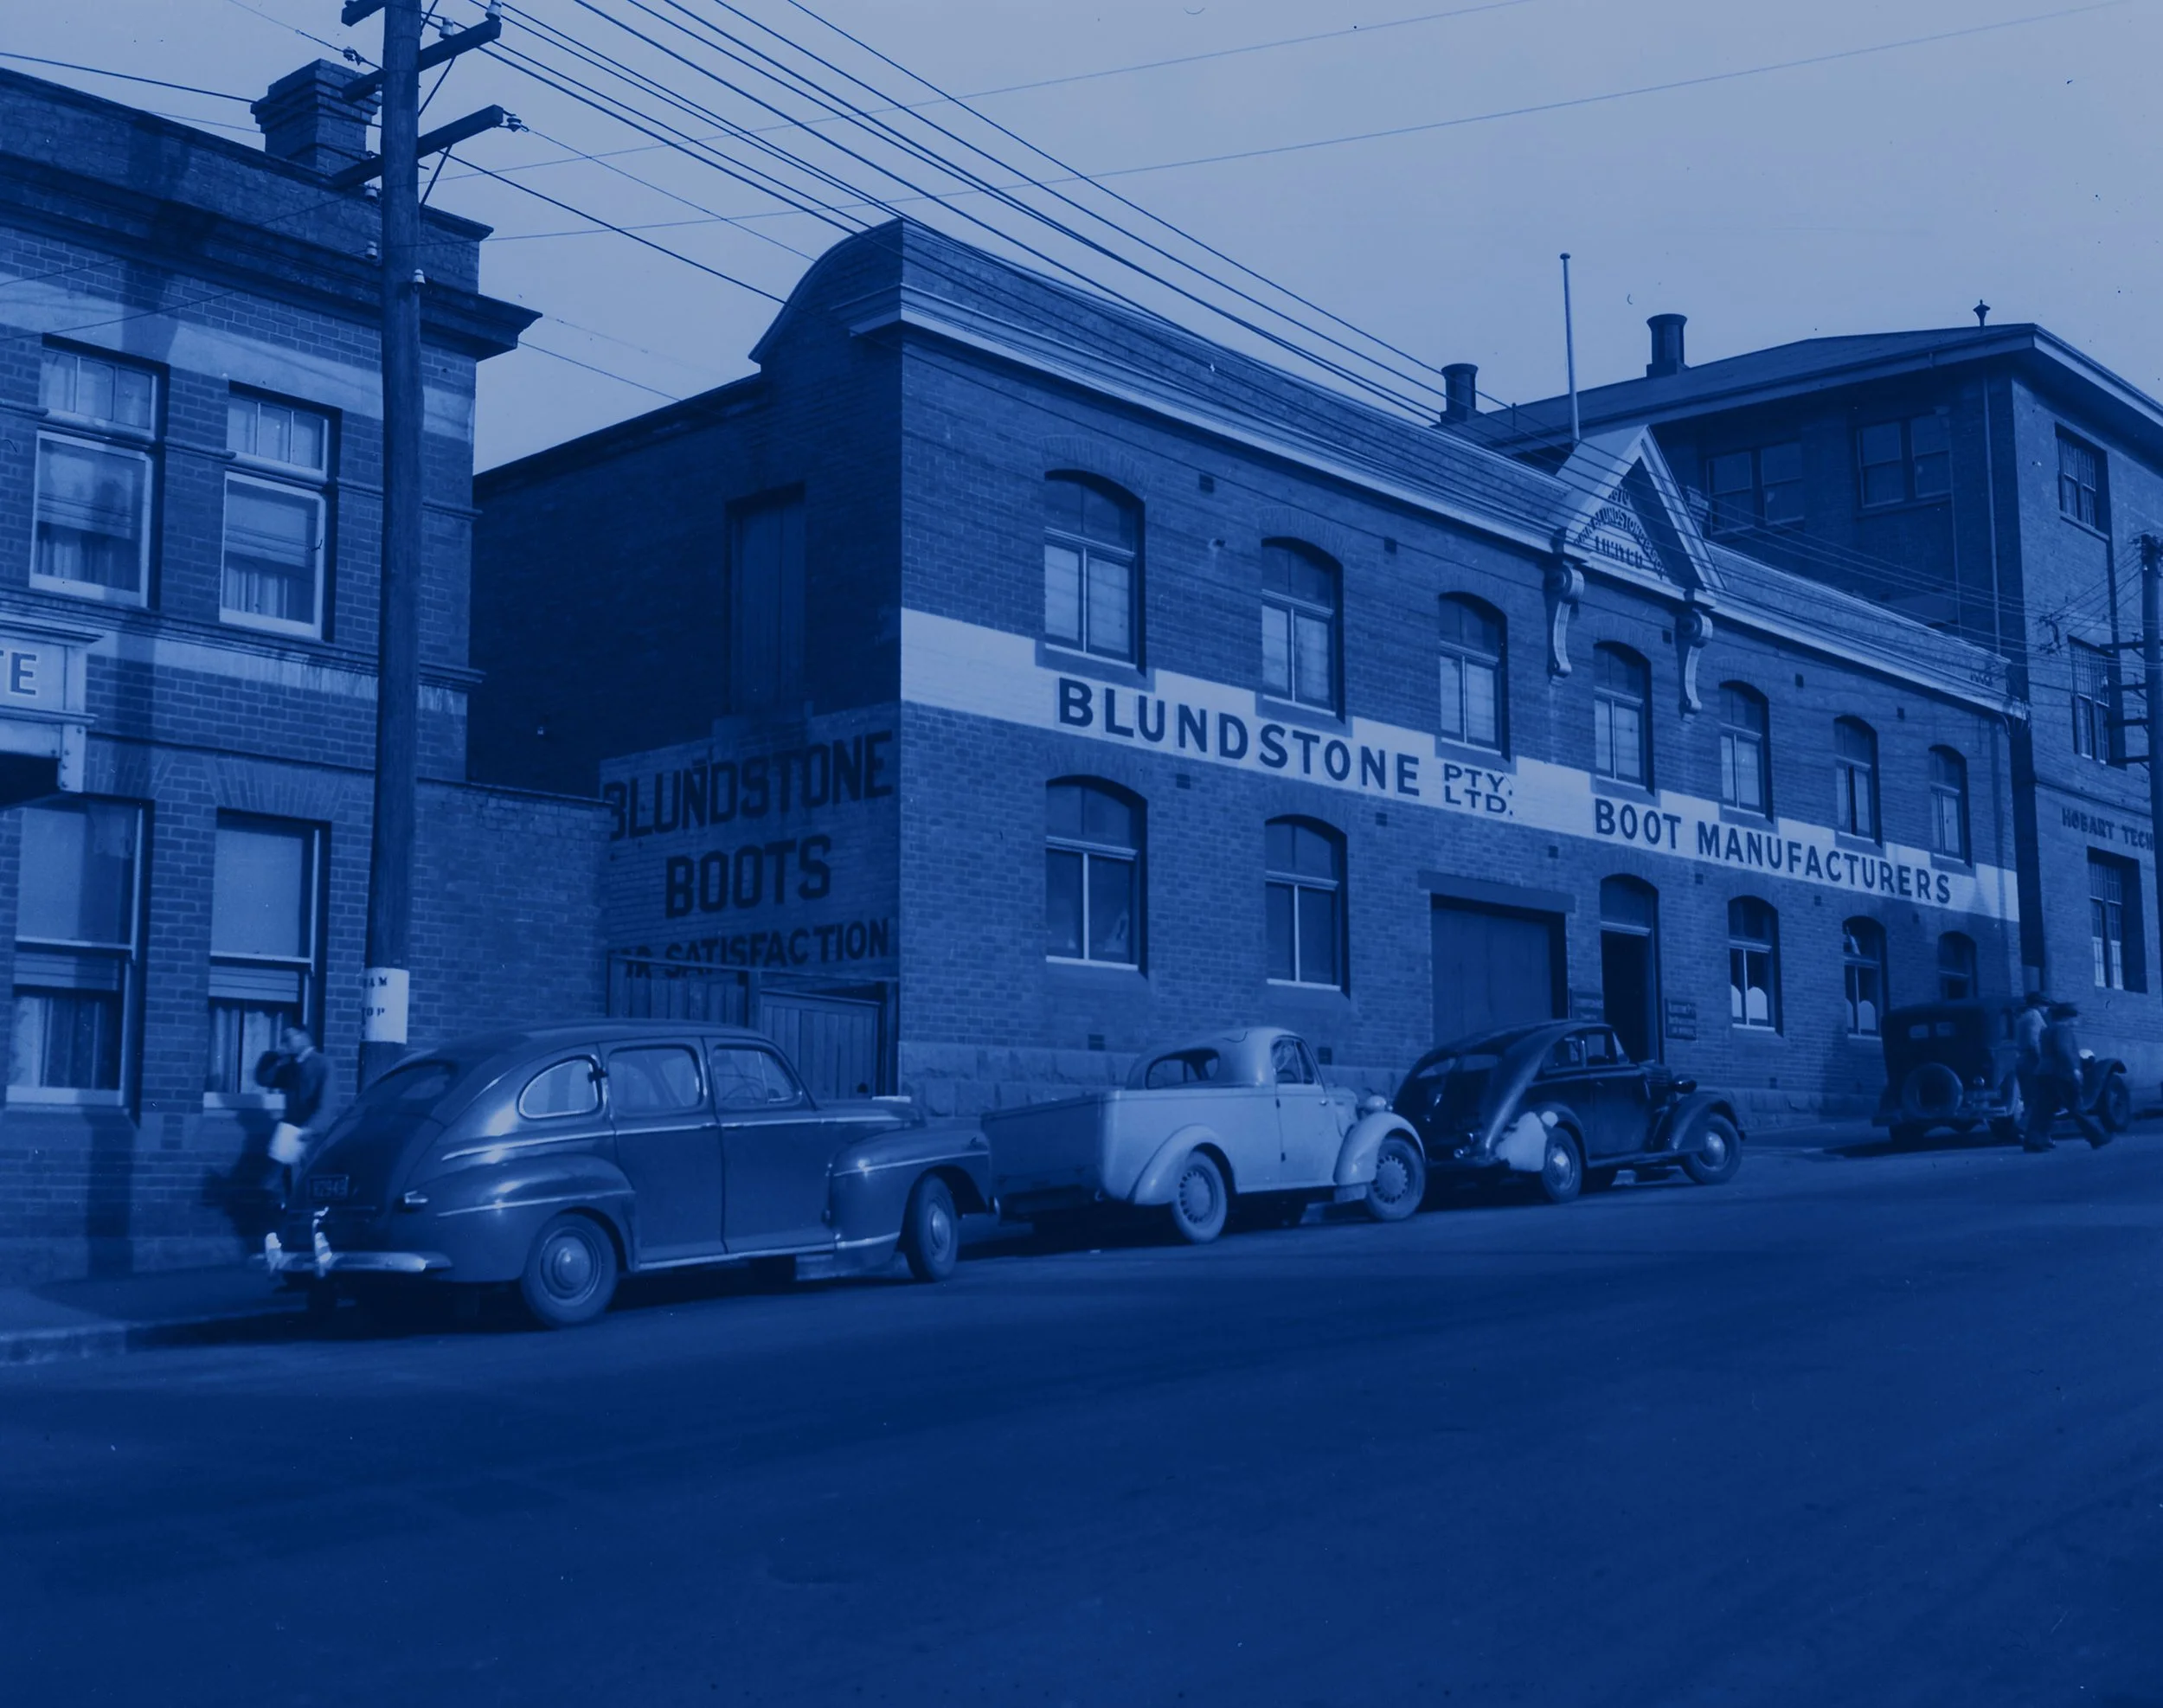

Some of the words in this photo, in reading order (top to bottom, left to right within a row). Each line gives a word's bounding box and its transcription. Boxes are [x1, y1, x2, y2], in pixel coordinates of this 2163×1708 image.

[0, 649, 36, 696] E
[1059, 677, 1420, 797] BLUNDSTONE
[602, 729, 893, 842] BLUNDSTONE
[1444, 785, 1513, 816] LTD.
[1595, 797, 1682, 851] BOOT
[1698, 820, 1952, 905] MANUFACTURERS
[2061, 806, 2115, 841] HOBART
[665, 834, 831, 919] BOOTS
[665, 917, 889, 979] SATISFACTION
